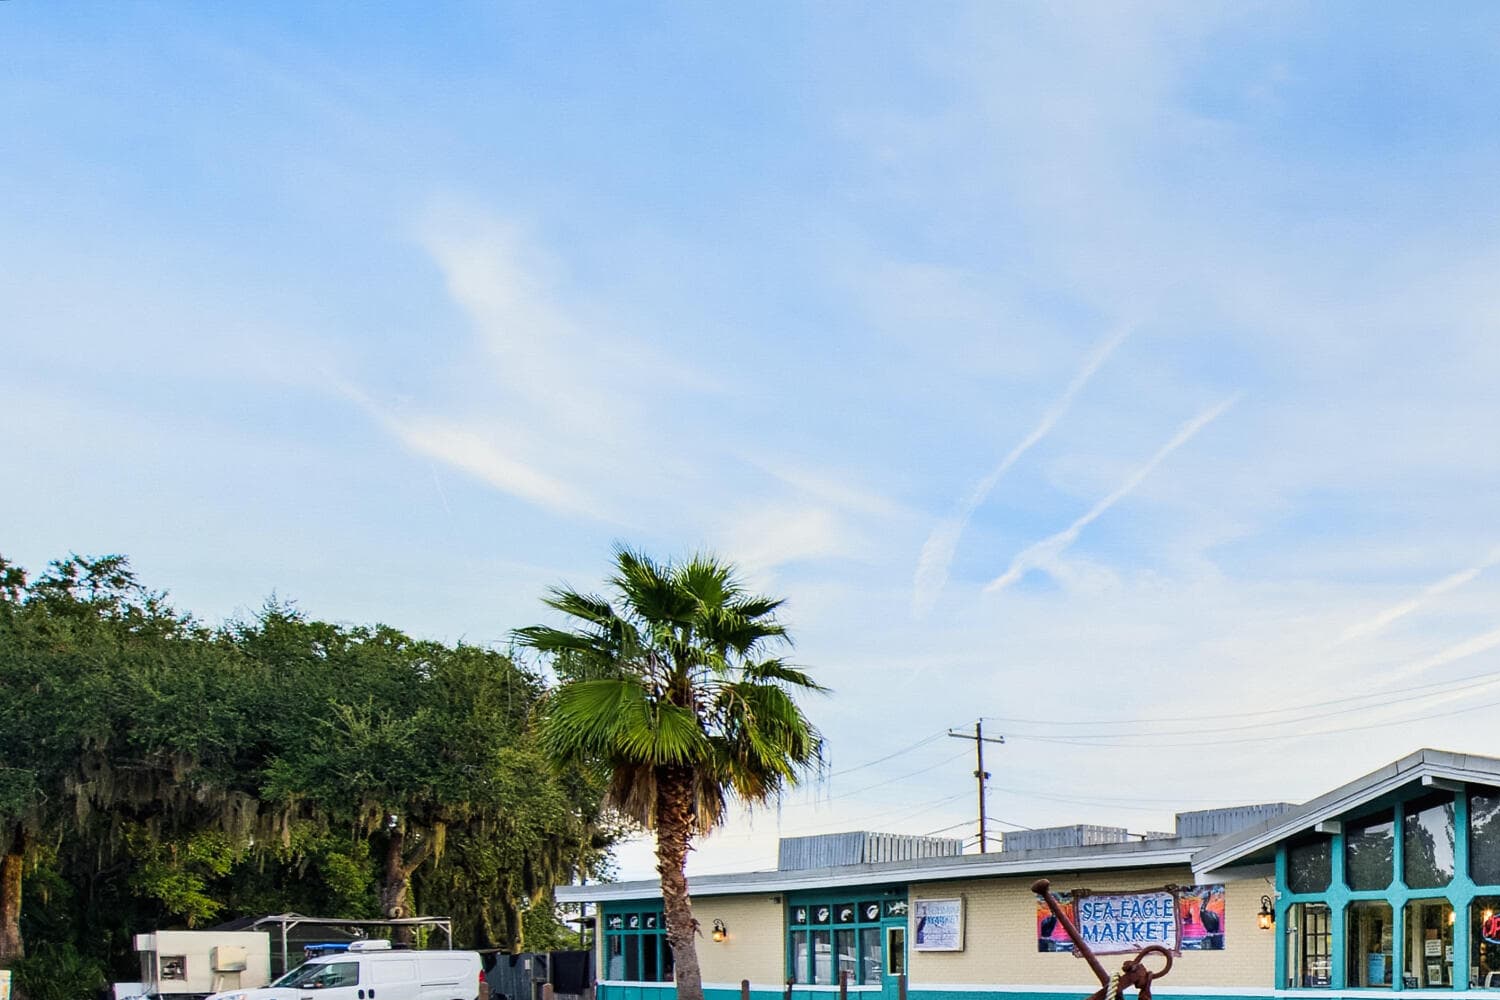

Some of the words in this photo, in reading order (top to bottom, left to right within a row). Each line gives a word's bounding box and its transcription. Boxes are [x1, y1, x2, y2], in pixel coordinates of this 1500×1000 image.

[1082, 902, 1113, 920] SEA
[1121, 899, 1173, 918] EAGLE
[1082, 921, 1173, 942] MARKET
